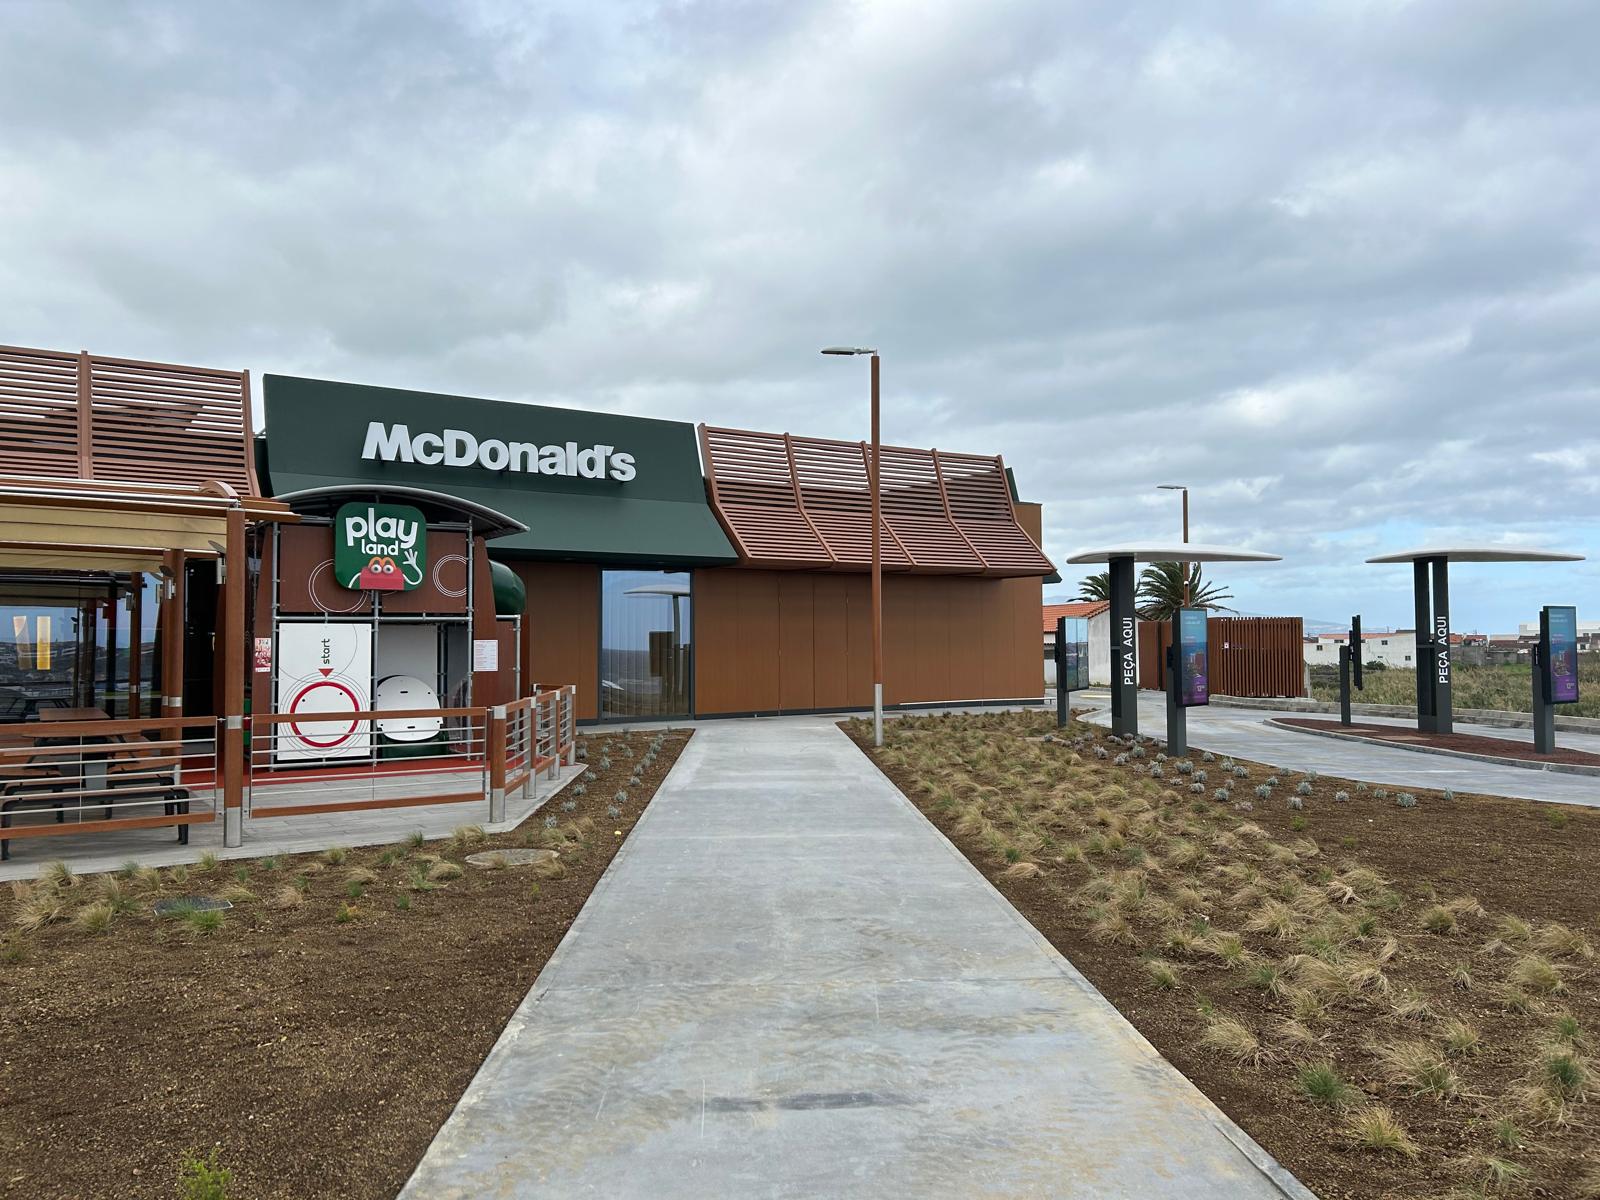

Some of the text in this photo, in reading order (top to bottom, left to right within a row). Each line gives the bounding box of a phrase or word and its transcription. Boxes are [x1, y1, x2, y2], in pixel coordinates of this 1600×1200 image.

[361, 421, 637, 482] McDonald's
[345, 507, 419, 549] play
[361, 538, 399, 556] land
[320, 638, 331, 665] start
[1122, 617, 1135, 685] PEÇA AQUI
[1437, 616, 1450, 684] PEÇA AQUI
